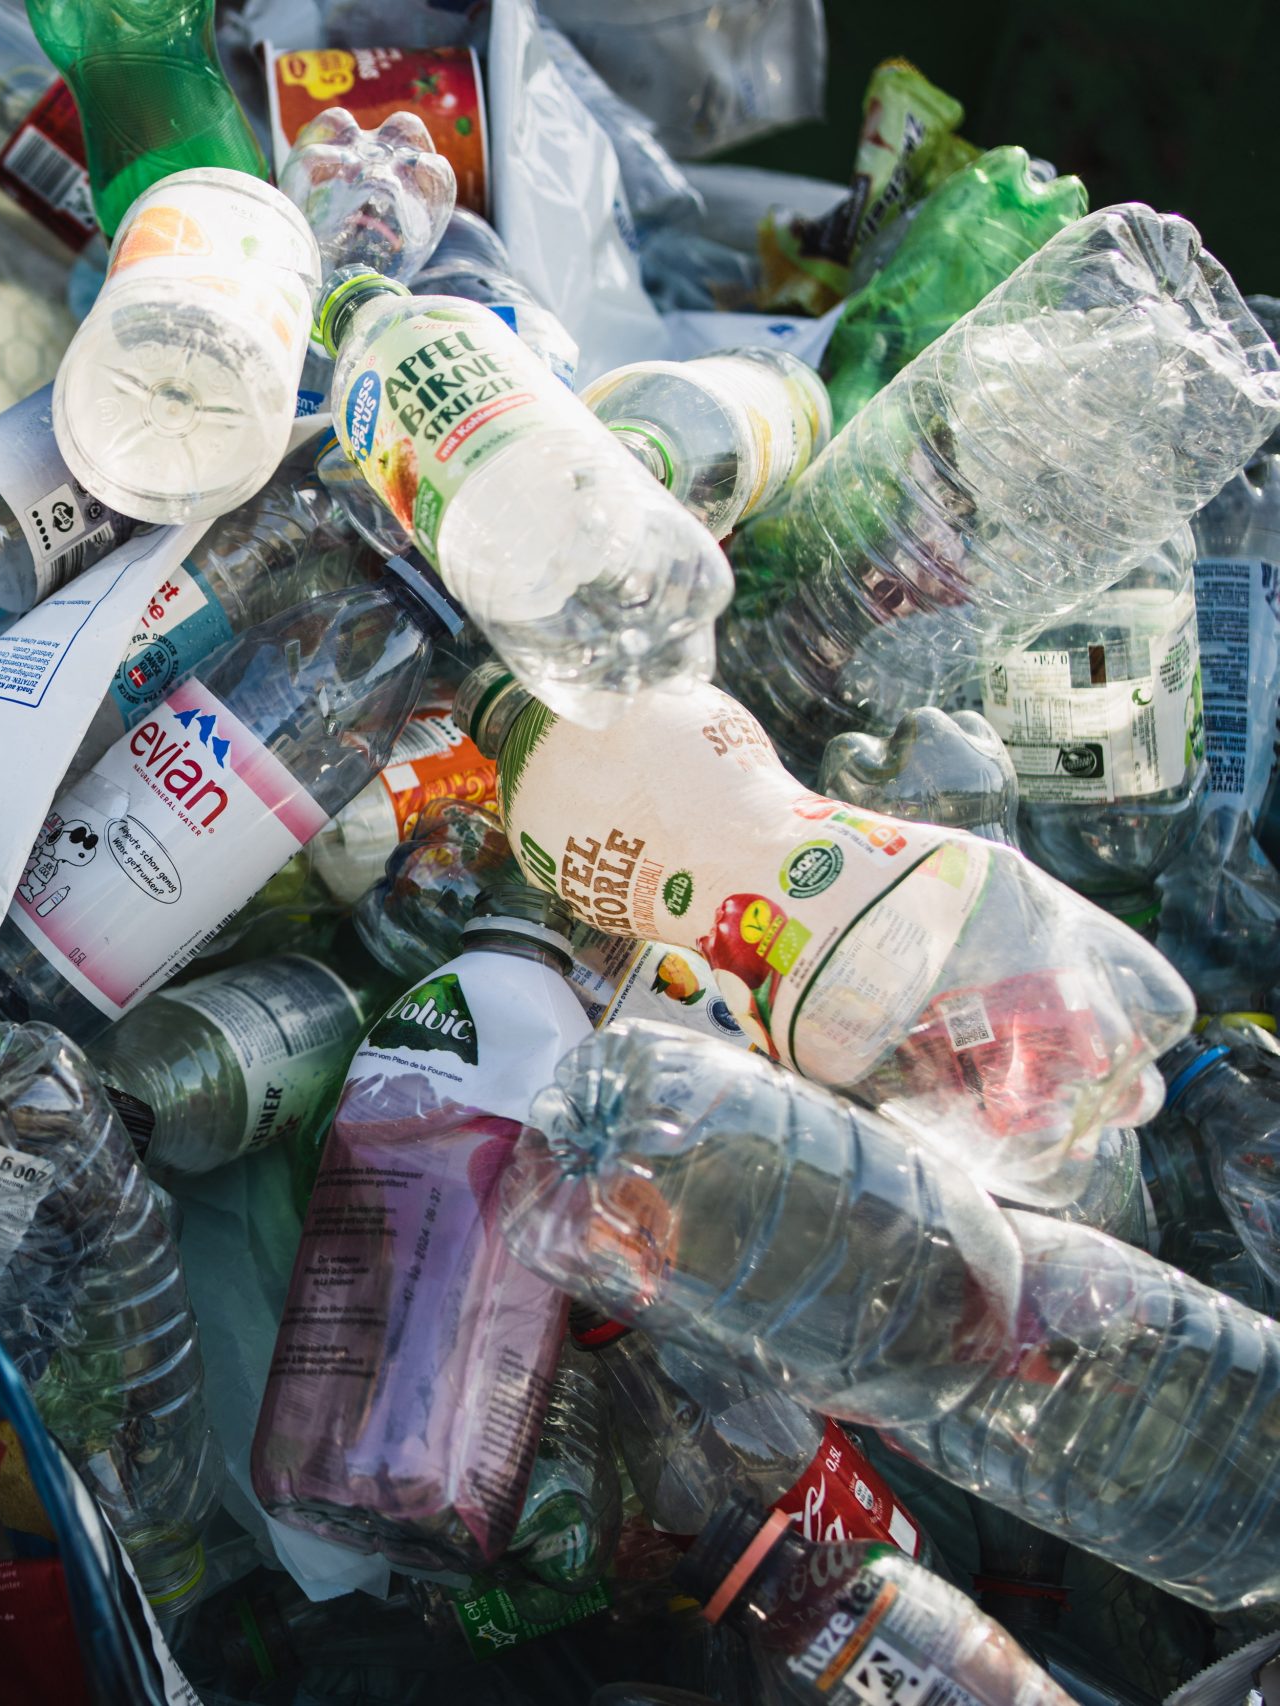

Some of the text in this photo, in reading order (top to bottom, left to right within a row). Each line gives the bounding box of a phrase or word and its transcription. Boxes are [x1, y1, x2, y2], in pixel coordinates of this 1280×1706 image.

[385, 331, 487, 410] APFEL
[351, 376, 374, 451] GENUSS
[399, 353, 509, 438] BIRNE
[359, 395, 376, 446] PLUS
[4, 683, 14, 691] auf
[11, 676, 37, 686] ZUTATEN:
[16, 686, 33, 694] Snack
[131, 721, 227, 828] evian
[132, 763, 202, 837] NATURAL MINERAL WATER
[125, 856, 164, 893] getrunken?
[139, 850, 160, 872] schon
[156, 871, 177, 893] genug
[667, 873, 688, 914] Trüb
[619, 984, 631, 1000] SMAG
[627, 973, 636, 985] MED
[385, 996, 473, 1038] Volvic
[391, 1056, 408, 1066] Piton
[409, 1061, 418, 1069] de
[419, 1063, 426, 1071] la
[426, 1066, 463, 1083] Fournaise
[17, 1164, 48, 1185] 200
[825, 1446, 842, 1472] 0,5L
[787, 1612, 856, 1678] fuze
